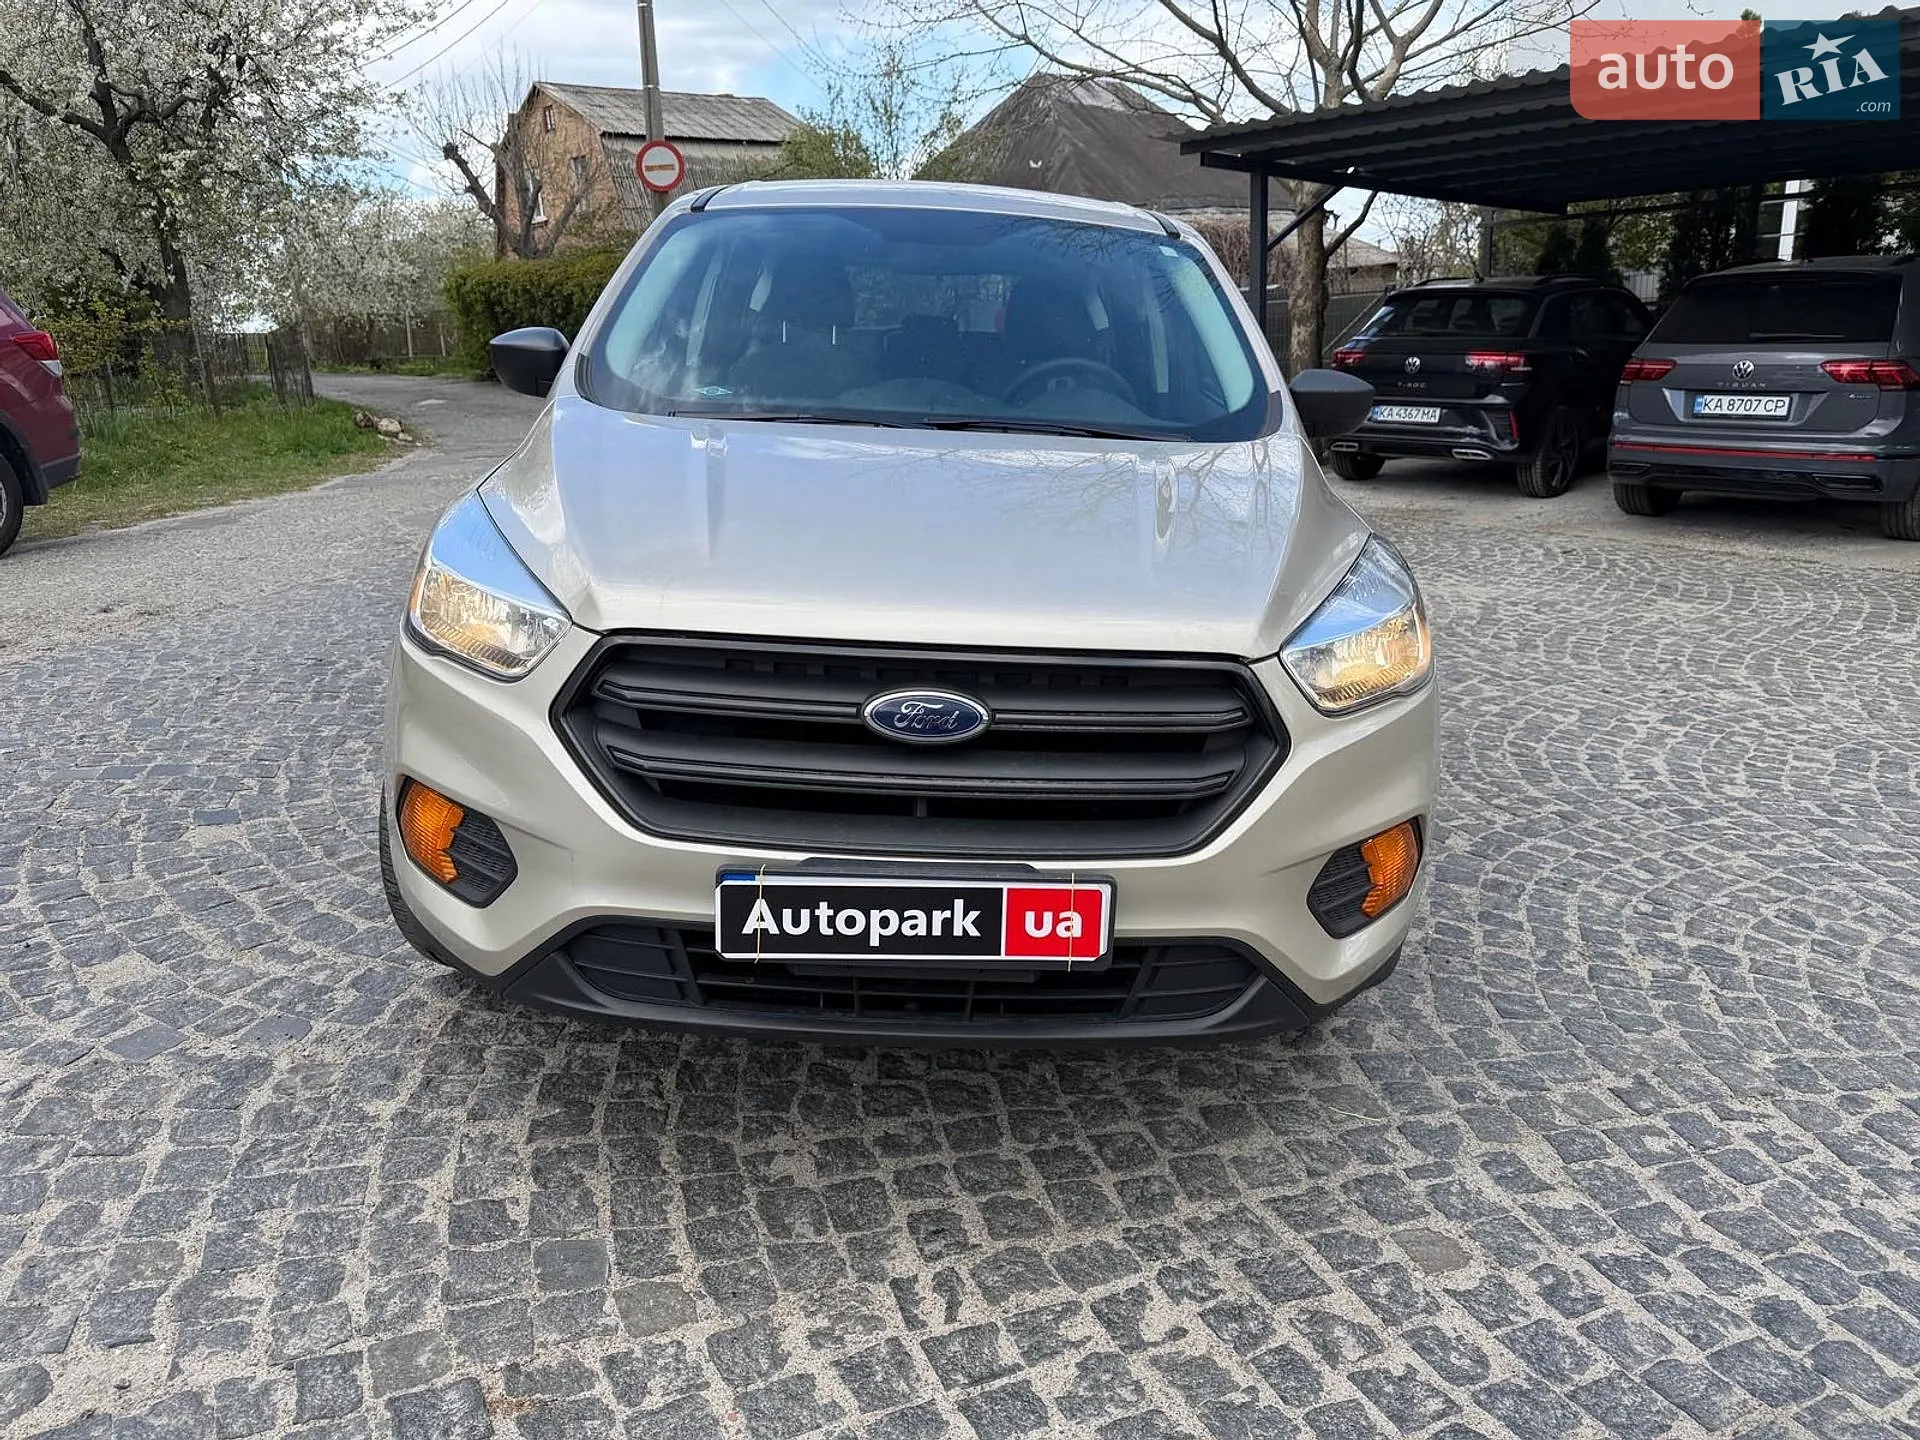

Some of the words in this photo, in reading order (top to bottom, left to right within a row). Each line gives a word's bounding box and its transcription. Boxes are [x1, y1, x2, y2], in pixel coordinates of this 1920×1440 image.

[1380, 407, 1393, 419] KA
[1396, 408, 1420, 420] 4367
[1421, 409, 1437, 421] MA
[1703, 398, 1723, 412] KA
[1727, 398, 1761, 412] 8707
[1764, 400, 1786, 413] CP
[894, 701, 960, 730] Ford
[741, 898, 982, 947] Autopark
[1024, 910, 1083, 939] ua
